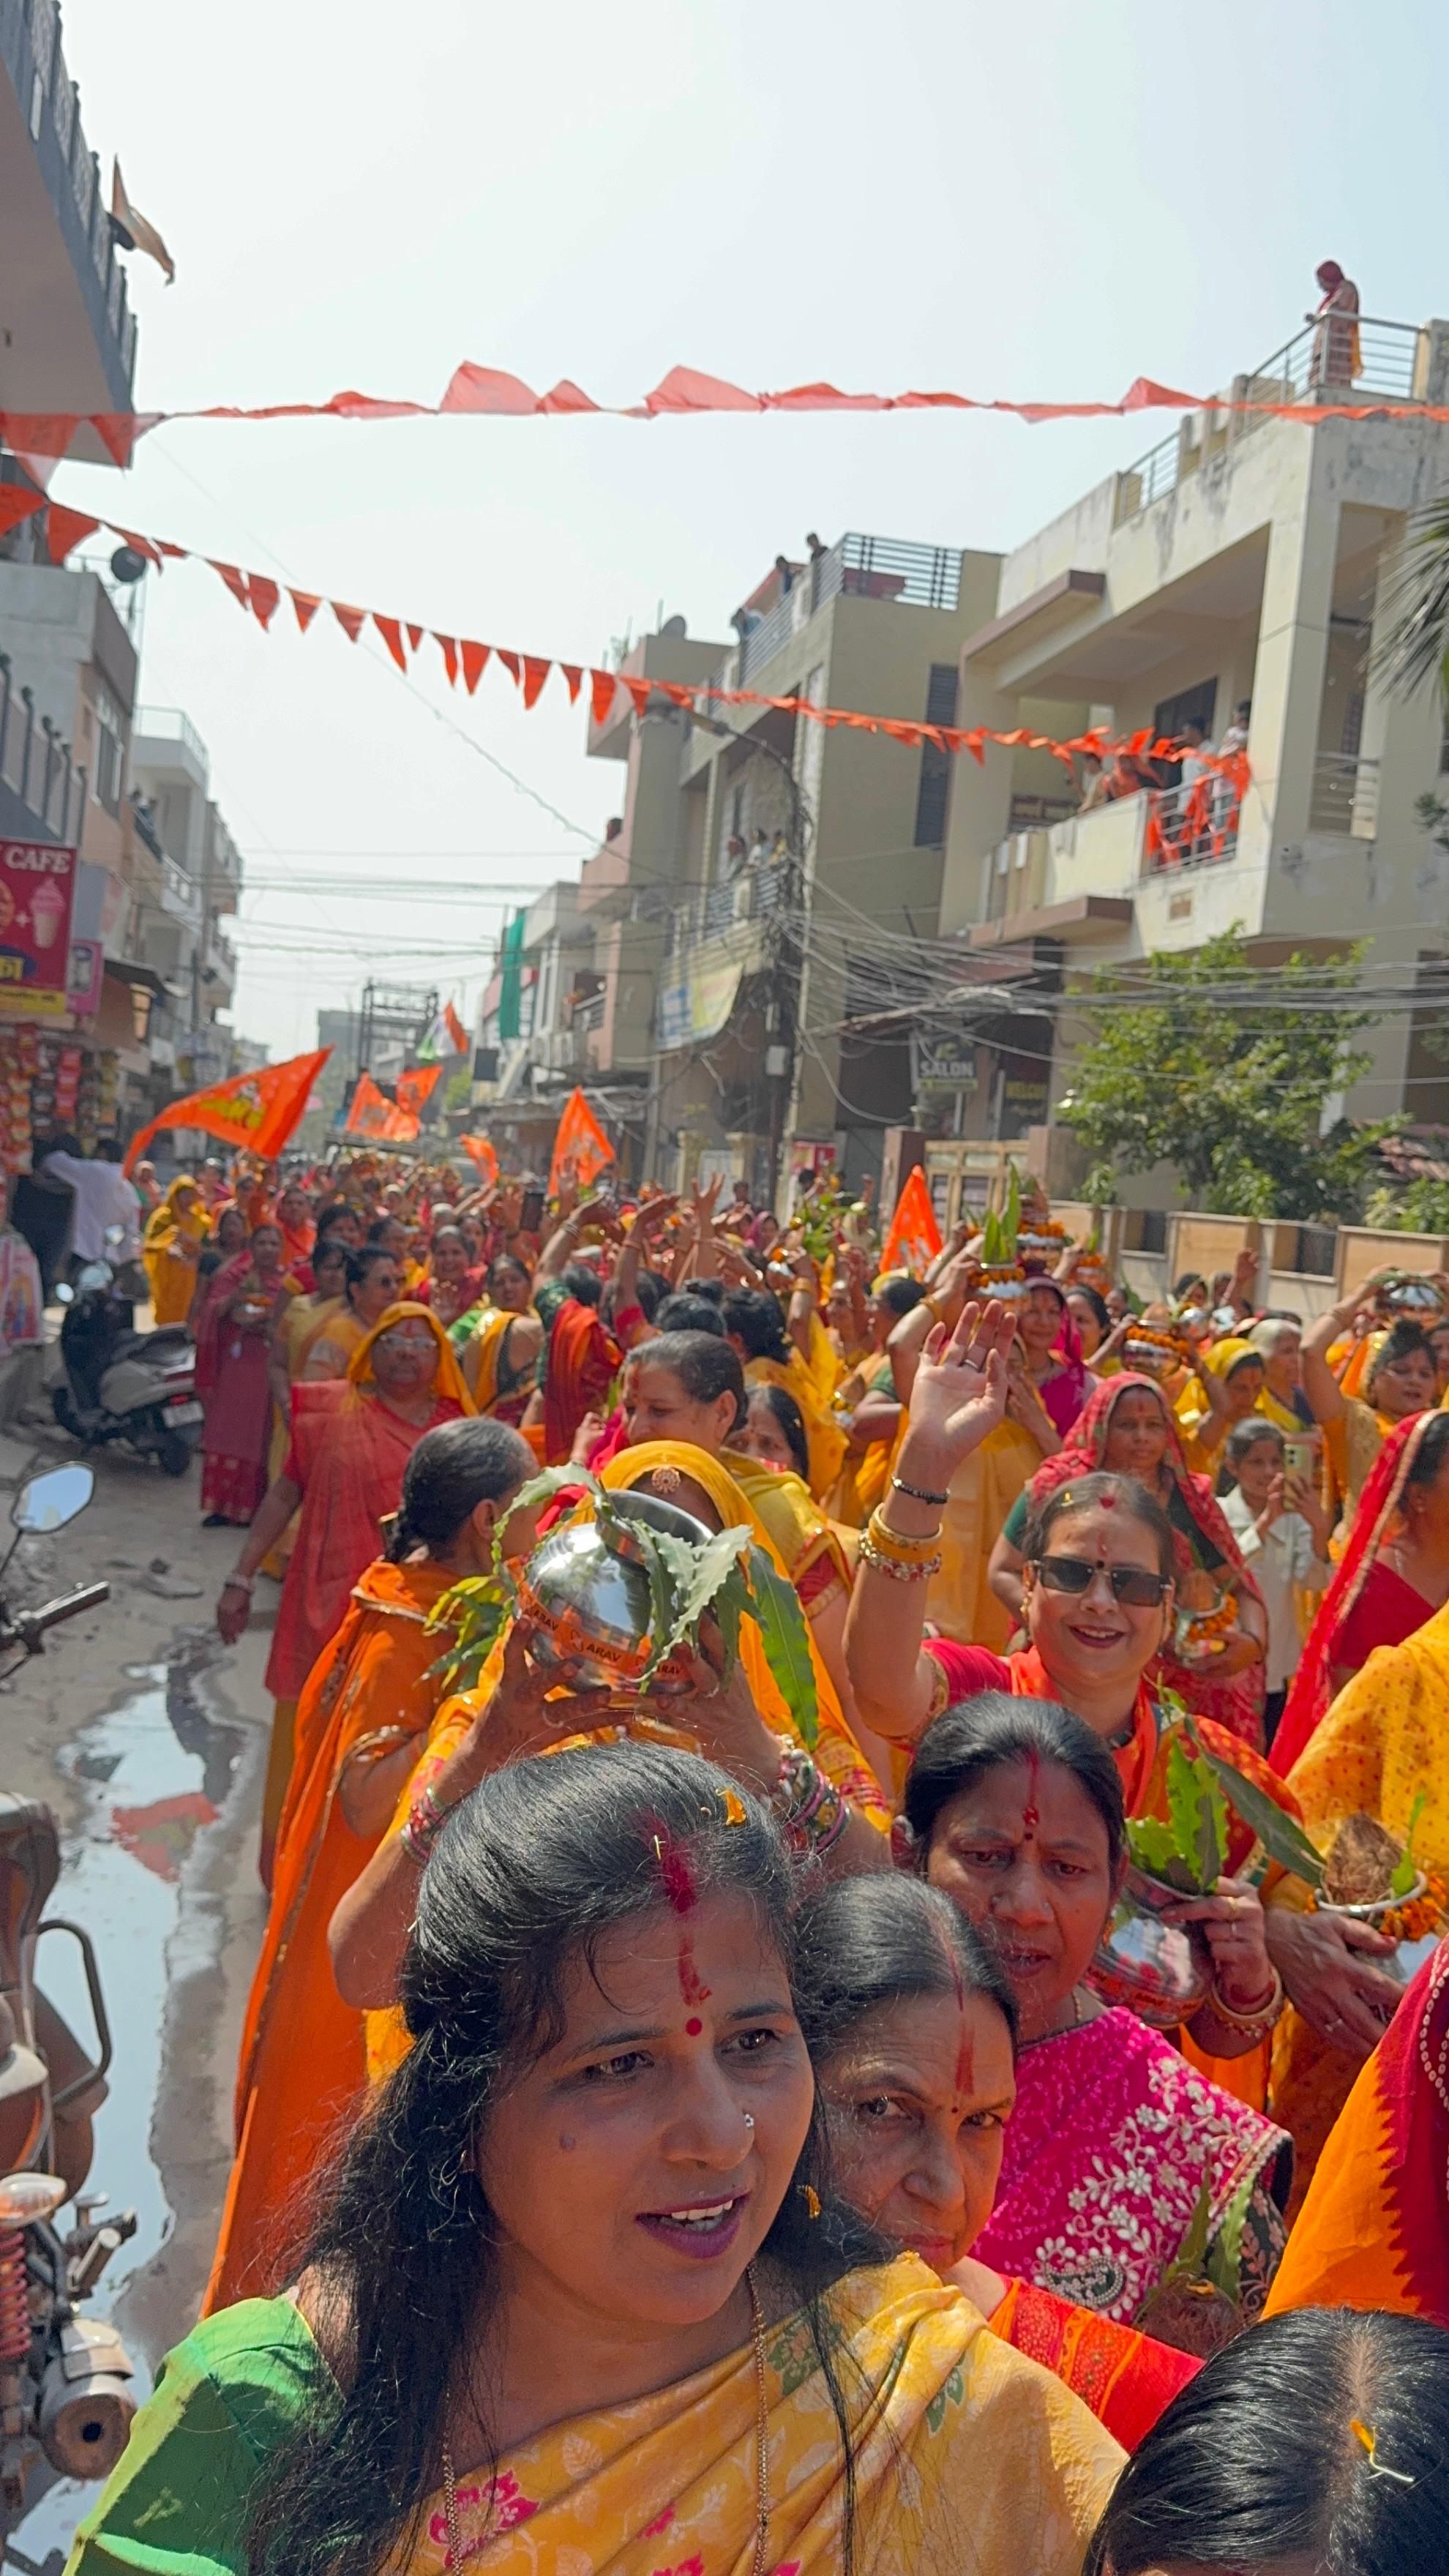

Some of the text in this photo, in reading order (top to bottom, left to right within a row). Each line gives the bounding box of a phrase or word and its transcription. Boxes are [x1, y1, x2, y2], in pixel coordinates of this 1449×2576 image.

[6, 846, 71, 874] CAFE
[920, 1061, 974, 1078] SALON
[533, 1609, 559, 1630] ARAV
[586, 1644, 622, 1663] ARAV
